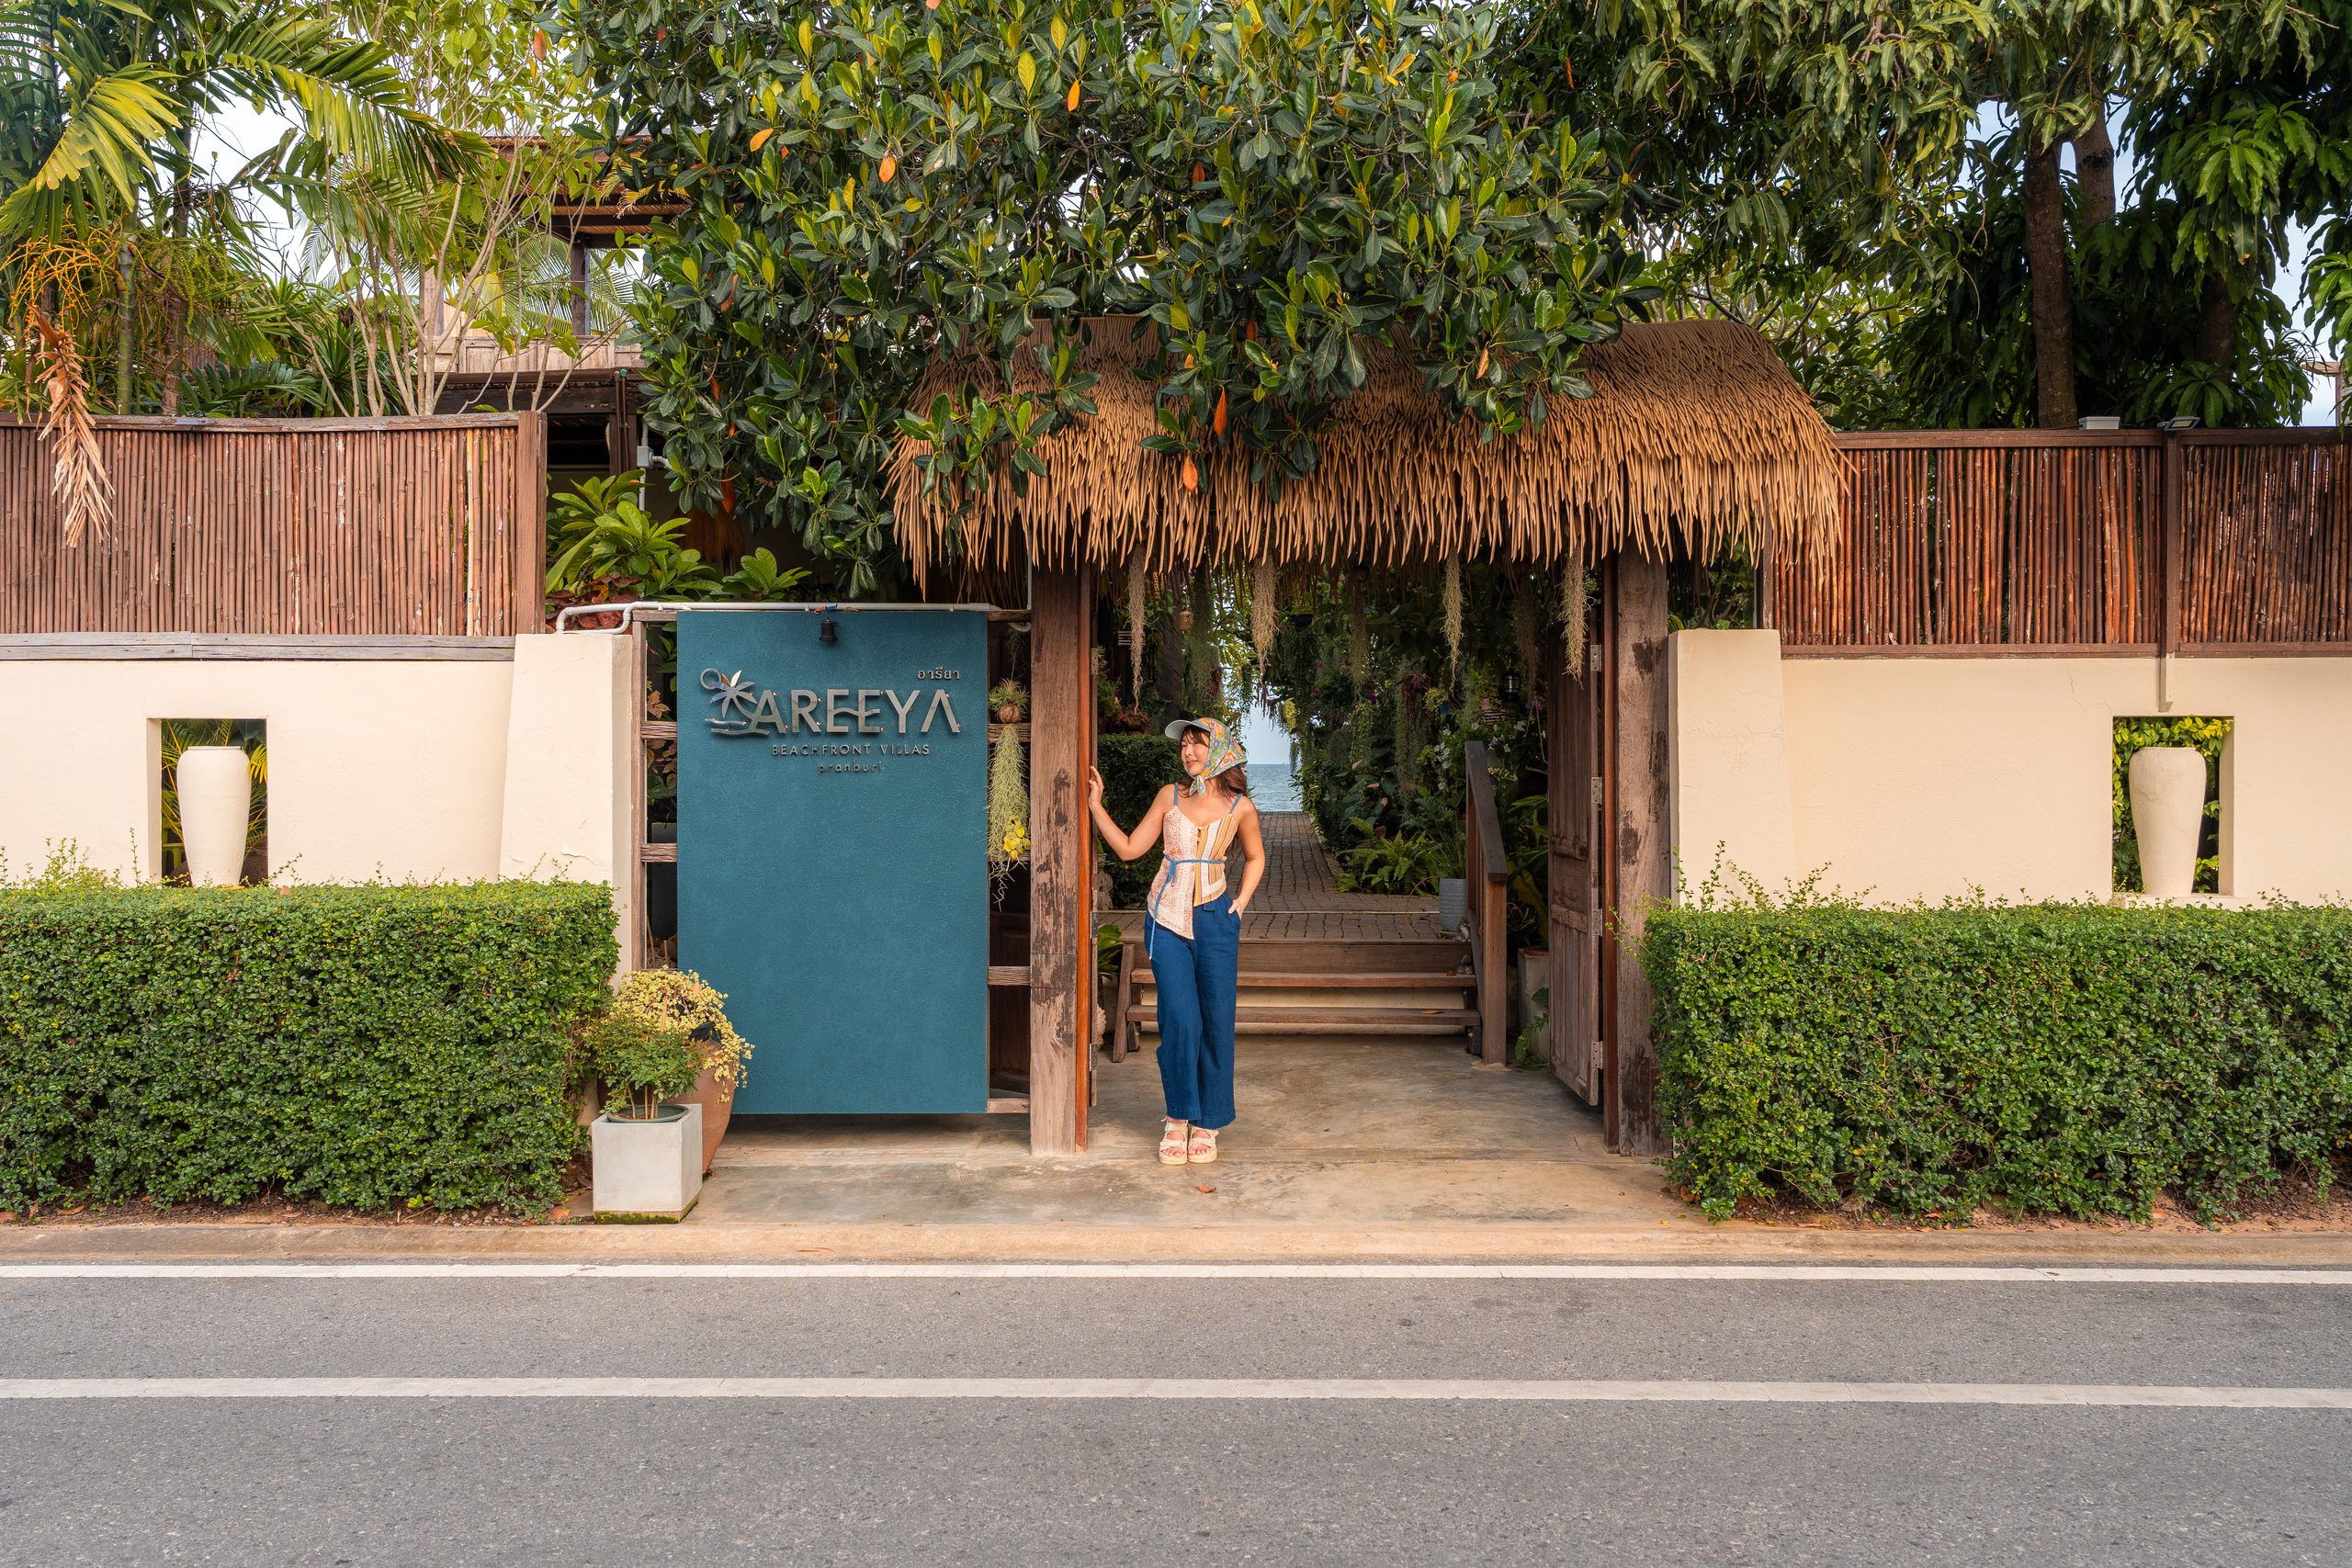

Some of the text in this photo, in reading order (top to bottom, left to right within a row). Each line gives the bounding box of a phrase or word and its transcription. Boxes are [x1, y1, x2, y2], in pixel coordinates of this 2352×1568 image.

[918, 665, 961, 680] อารียา
[750, 689, 961, 734] AREEYA
[771, 744, 931, 755] BEACHFRONT VILLAS
[818, 760, 885, 775] pranburi
